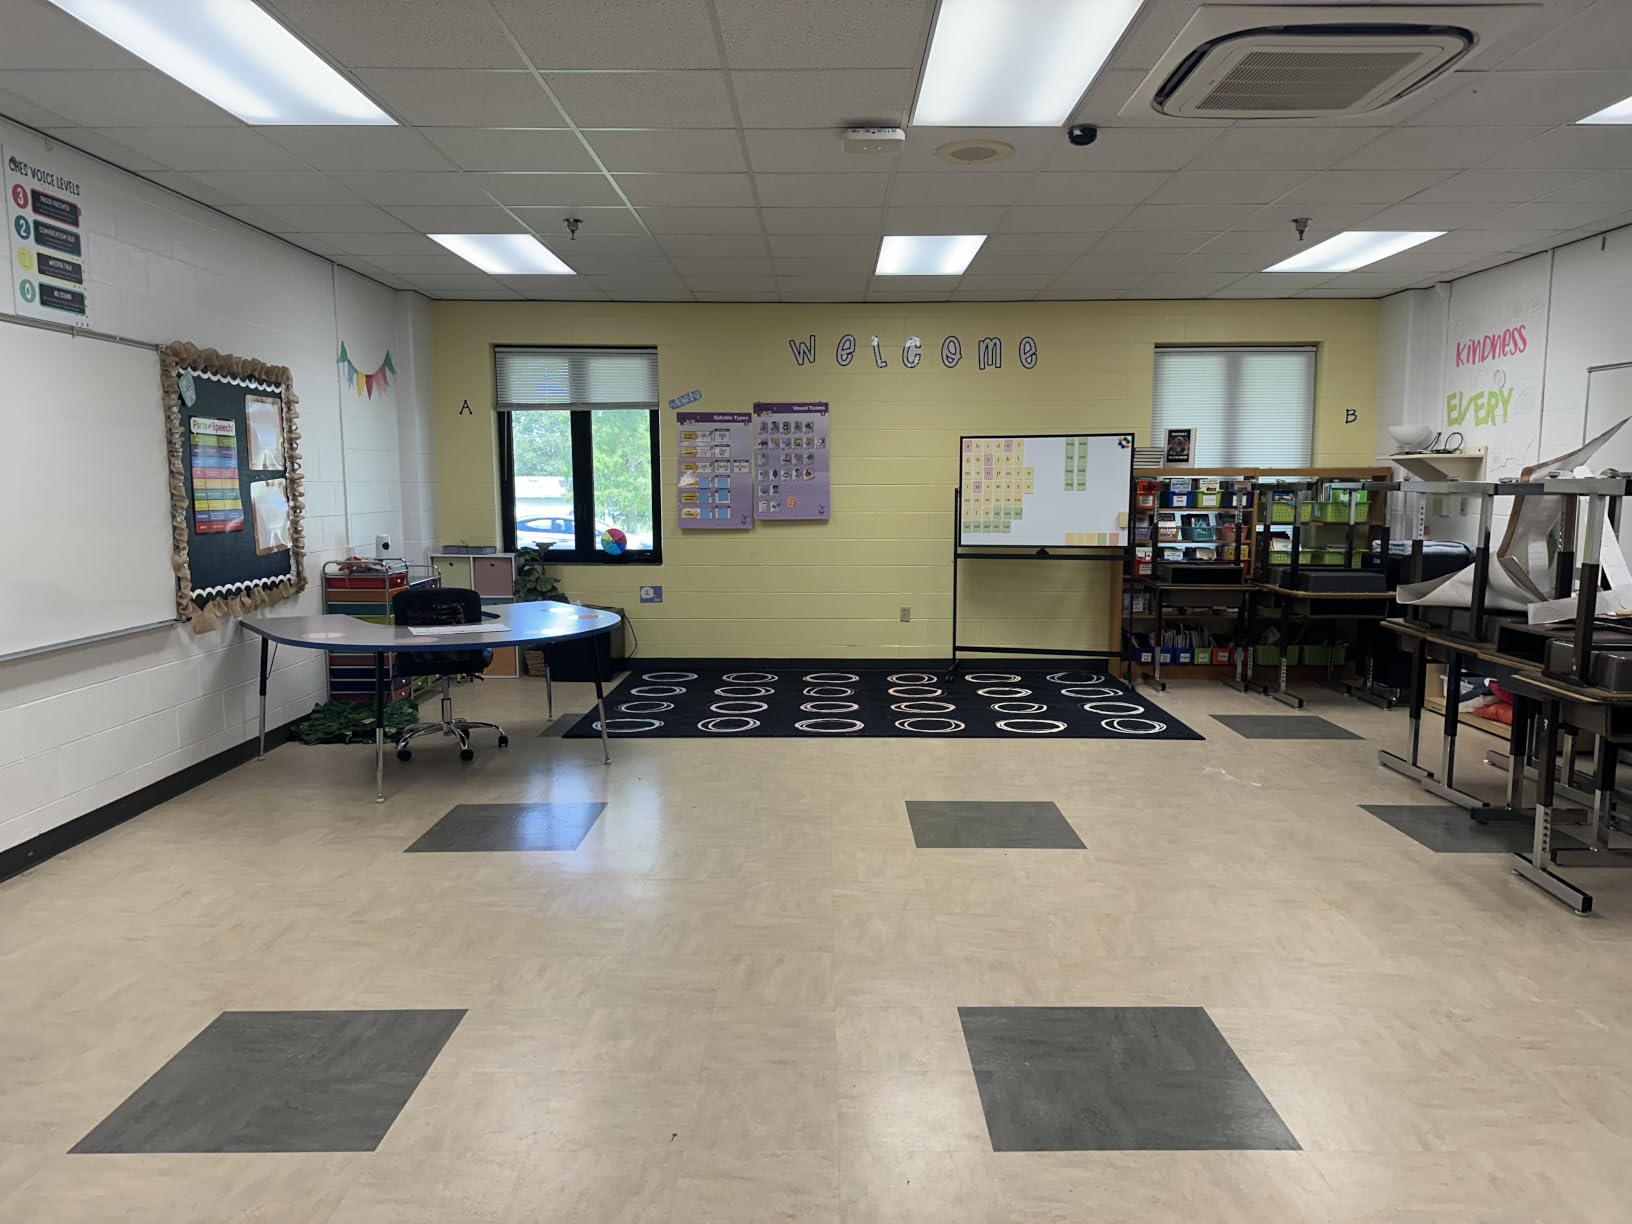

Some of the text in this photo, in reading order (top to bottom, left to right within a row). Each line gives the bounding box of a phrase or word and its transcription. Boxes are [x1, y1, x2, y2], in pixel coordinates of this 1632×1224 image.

[29, 167, 55, 187] VOICE
[56, 176, 80, 196] LEVELS
[16, 187, 24, 205] 3
[20, 220, 27, 237] 2
[459, 400, 473, 415] A
[1446, 386, 1514, 427] EVERY
[1345, 408, 1358, 424] B
[212, 423, 233, 434] Speech
